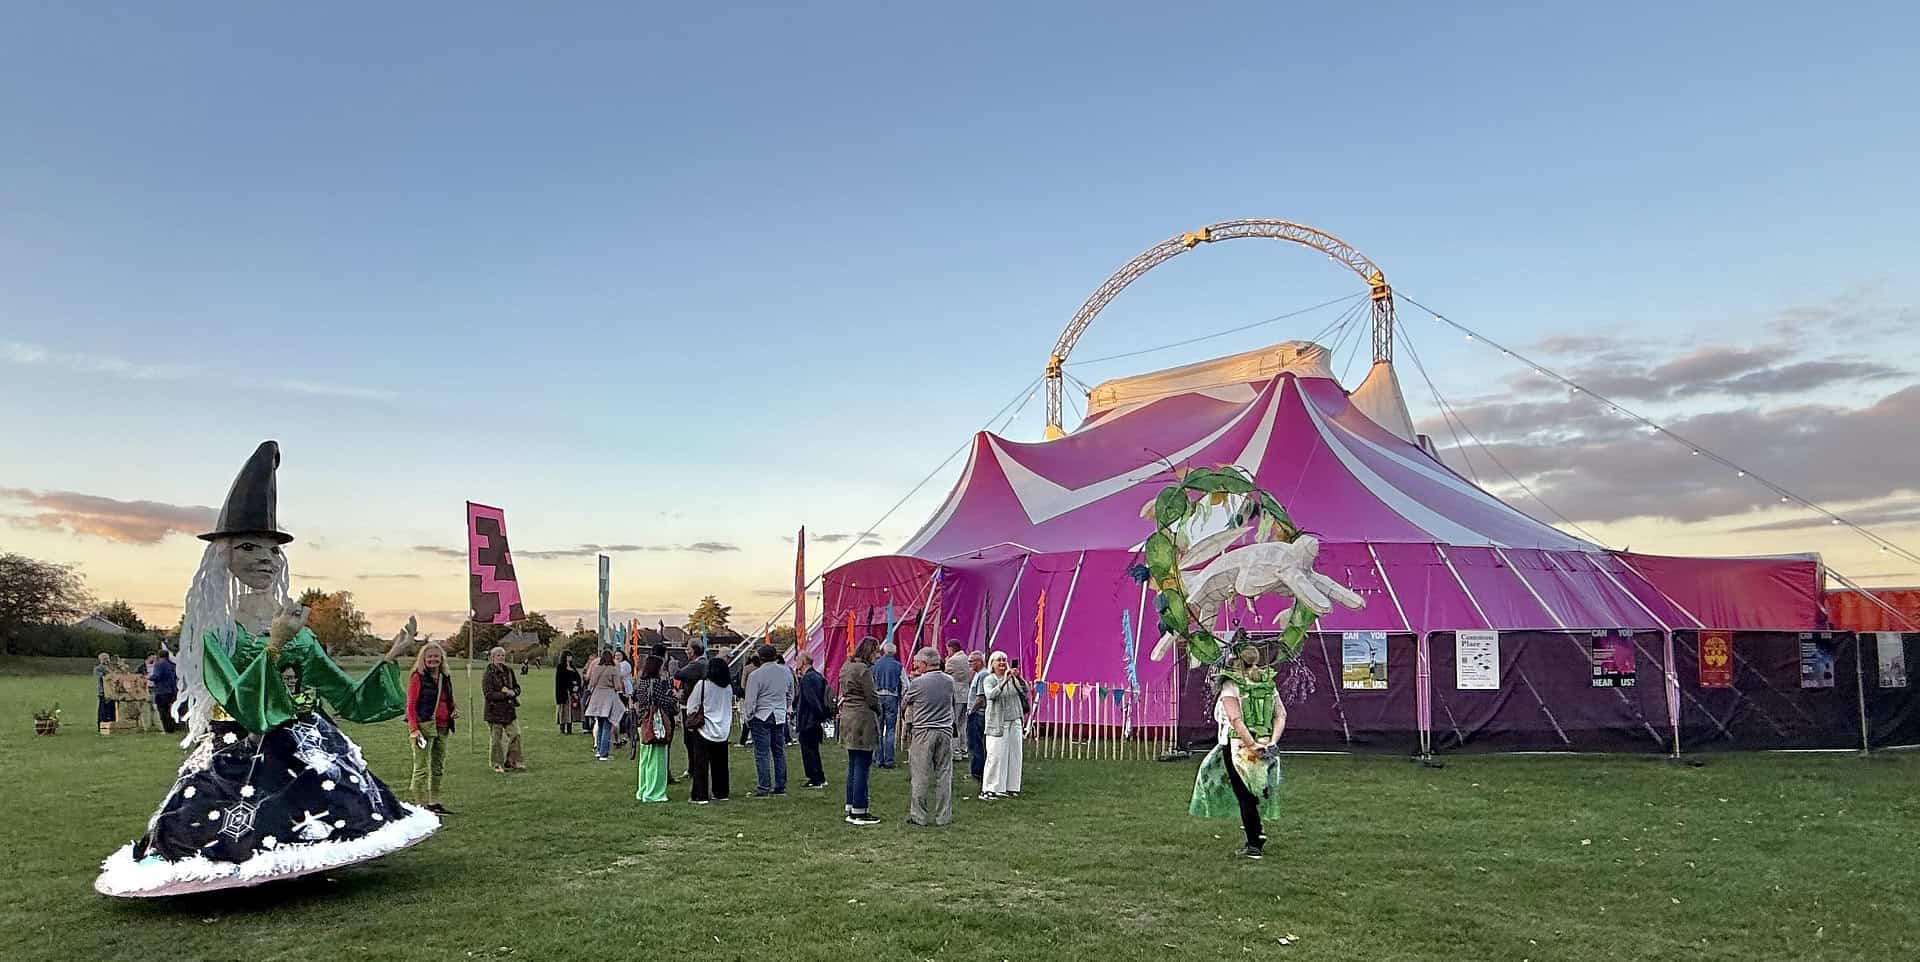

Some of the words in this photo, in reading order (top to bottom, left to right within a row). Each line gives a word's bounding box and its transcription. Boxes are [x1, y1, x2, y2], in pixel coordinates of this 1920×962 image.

[1343, 632, 1359, 640] CAN
[1370, 632, 1386, 640] YOU
[1591, 629, 1608, 637] CAN
[1617, 629, 1633, 637] YOU
[1343, 680, 1365, 689] HEAR
[1372, 680, 1388, 689] US?
[1592, 678, 1613, 687] HEAR
[1620, 678, 1635, 687] US?
